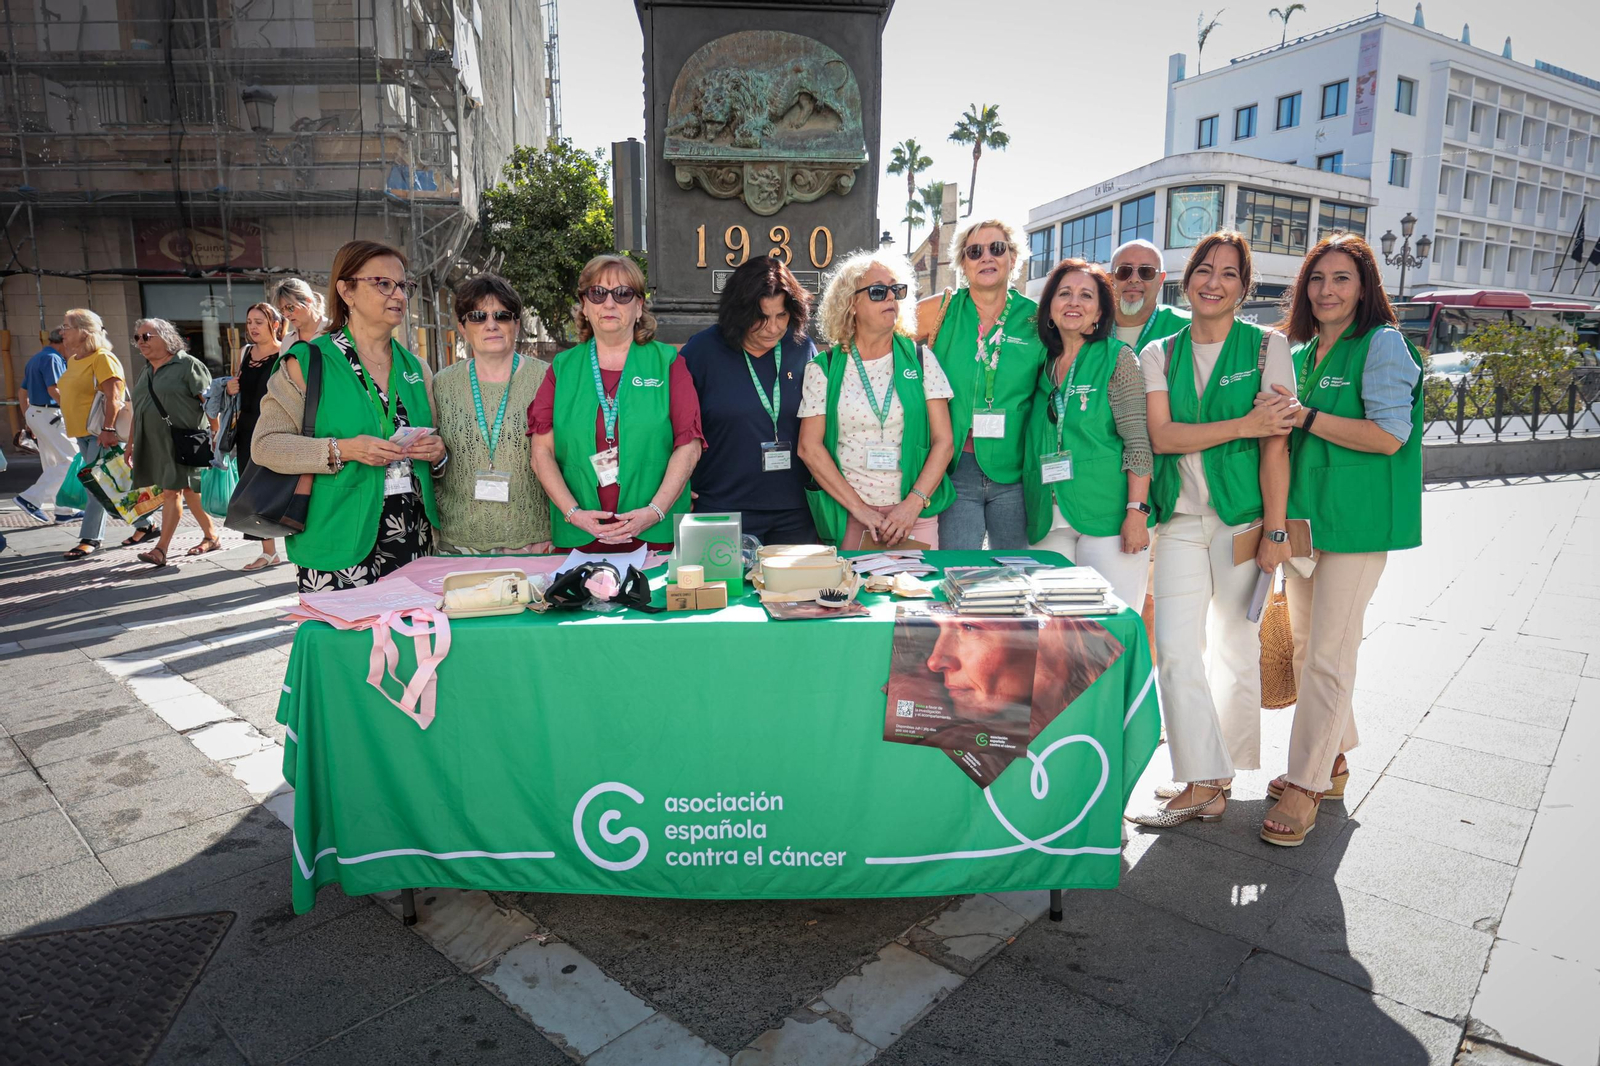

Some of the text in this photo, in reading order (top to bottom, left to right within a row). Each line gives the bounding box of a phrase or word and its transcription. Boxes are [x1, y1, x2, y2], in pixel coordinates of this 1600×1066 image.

[1102, 181, 1114, 193] VEGA
[696, 224, 833, 268] 1930
[664, 791, 783, 812] asociación
[664, 819, 767, 844] española
[666, 846, 847, 867] contra el cáncer
